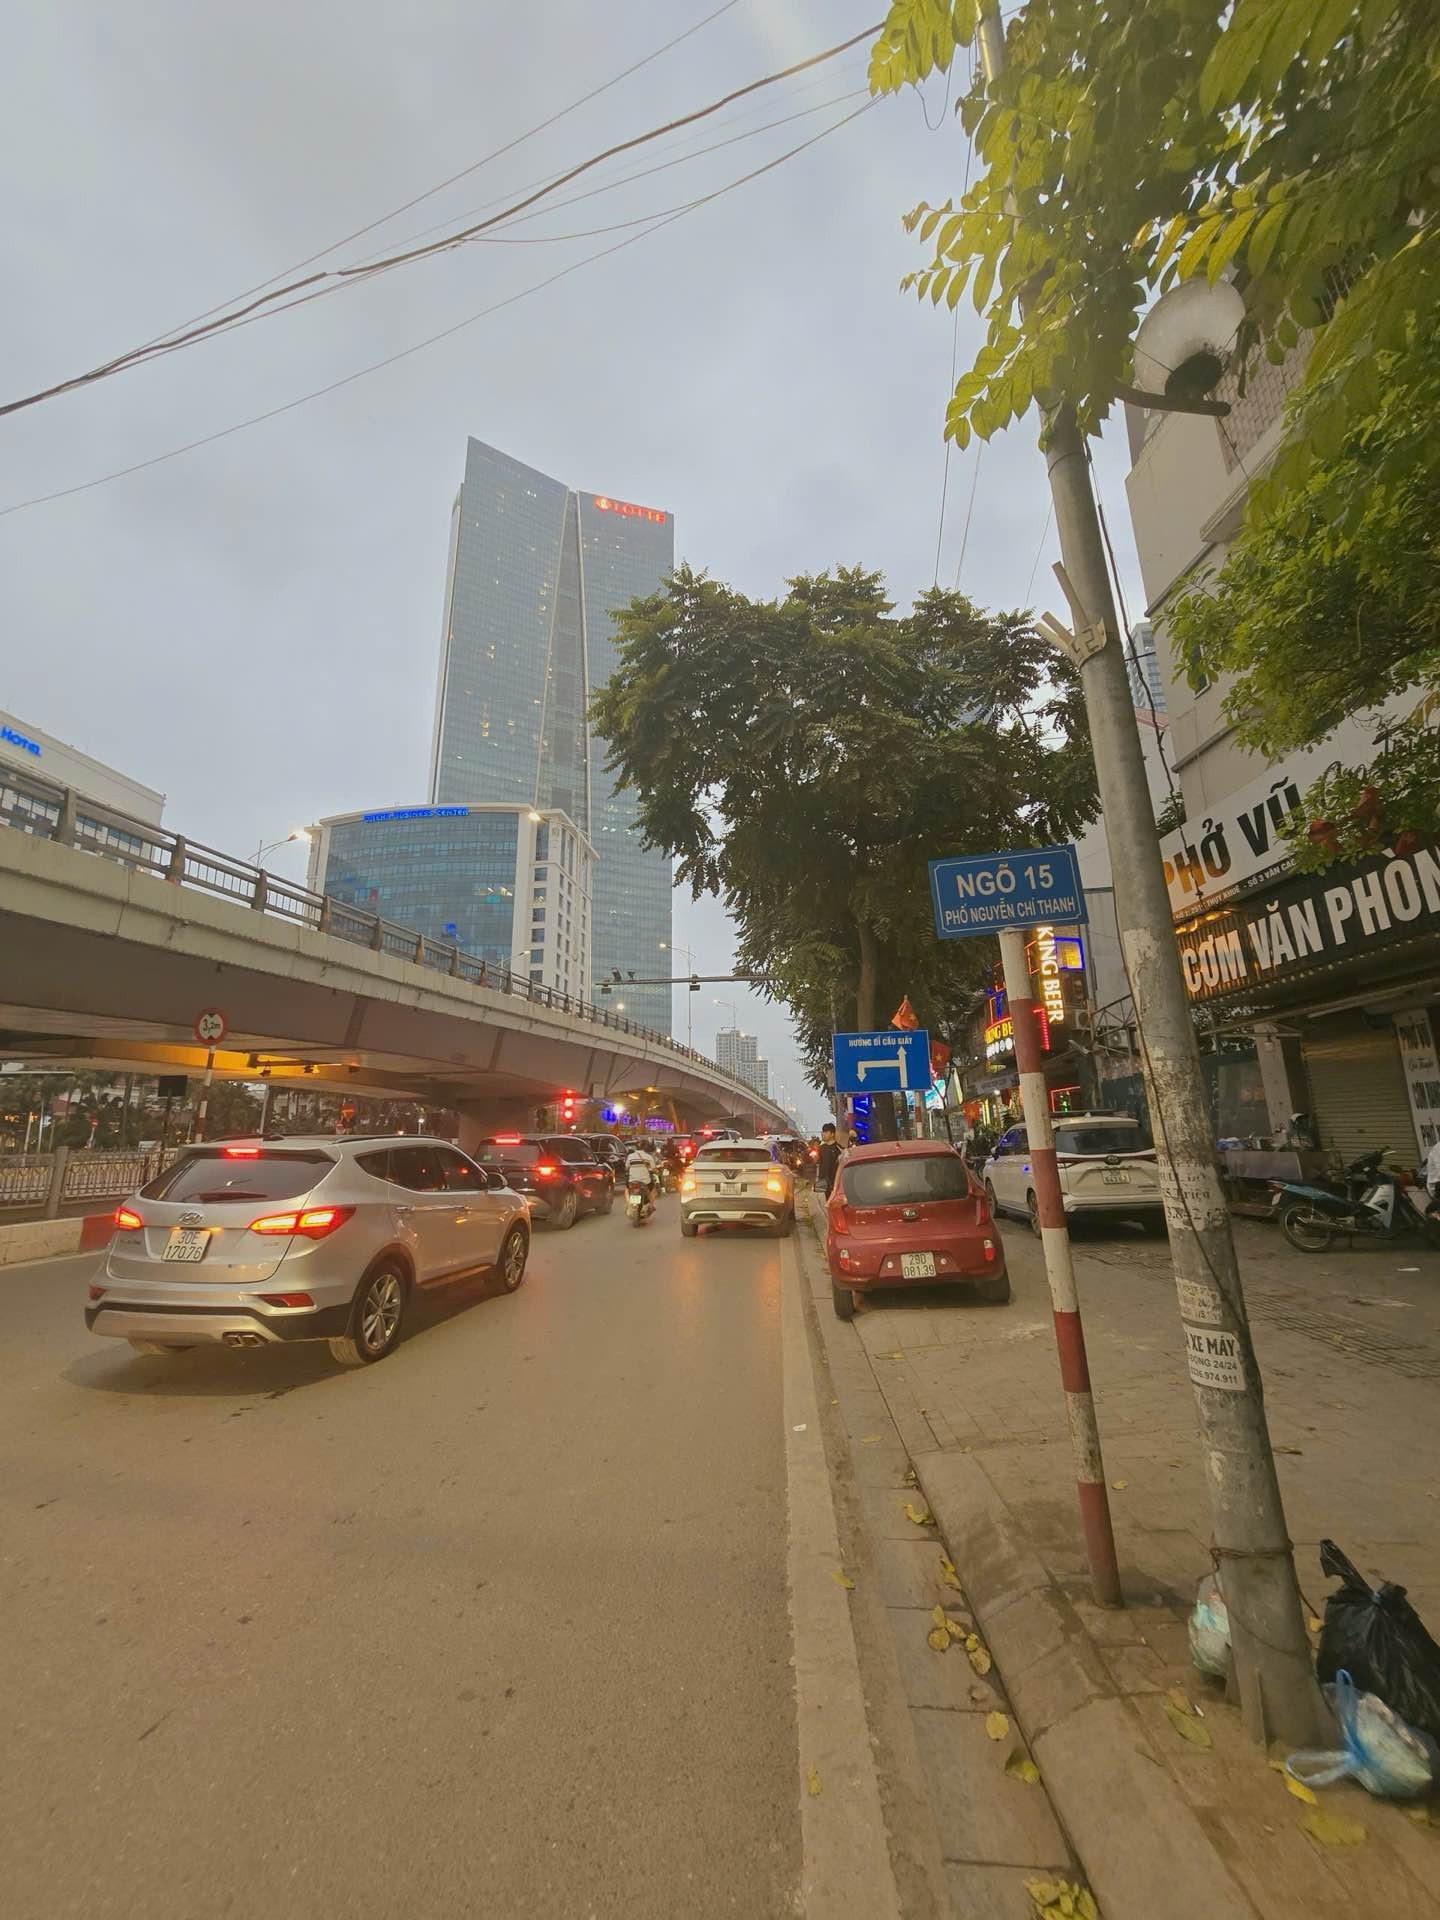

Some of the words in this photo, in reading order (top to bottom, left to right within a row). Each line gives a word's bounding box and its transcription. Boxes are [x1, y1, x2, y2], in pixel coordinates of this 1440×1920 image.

[955, 863, 1016, 898] NGÕ
[1024, 864, 1054, 890] 15
[945, 903, 968, 926] PHỐ
[970, 897, 1015, 923] NGUYỄN
[1017, 897, 1036, 917] CHÍ
[1037, 896, 1076, 914] THANH
[1036, 926, 1059, 976] KING
[1182, 930, 1247, 993] CƠM
[1247, 900, 1324, 971] VĂN
[1043, 979, 1065, 1023] BEER
[178, 1231, 201, 1245] 30E
[904, 1264, 935, 1277] 081.39
[1190, 1333, 1204, 1353] XE
[1206, 1335, 1235, 1356] MÁY
[1213, 1360, 1238, 1370] 24/24
